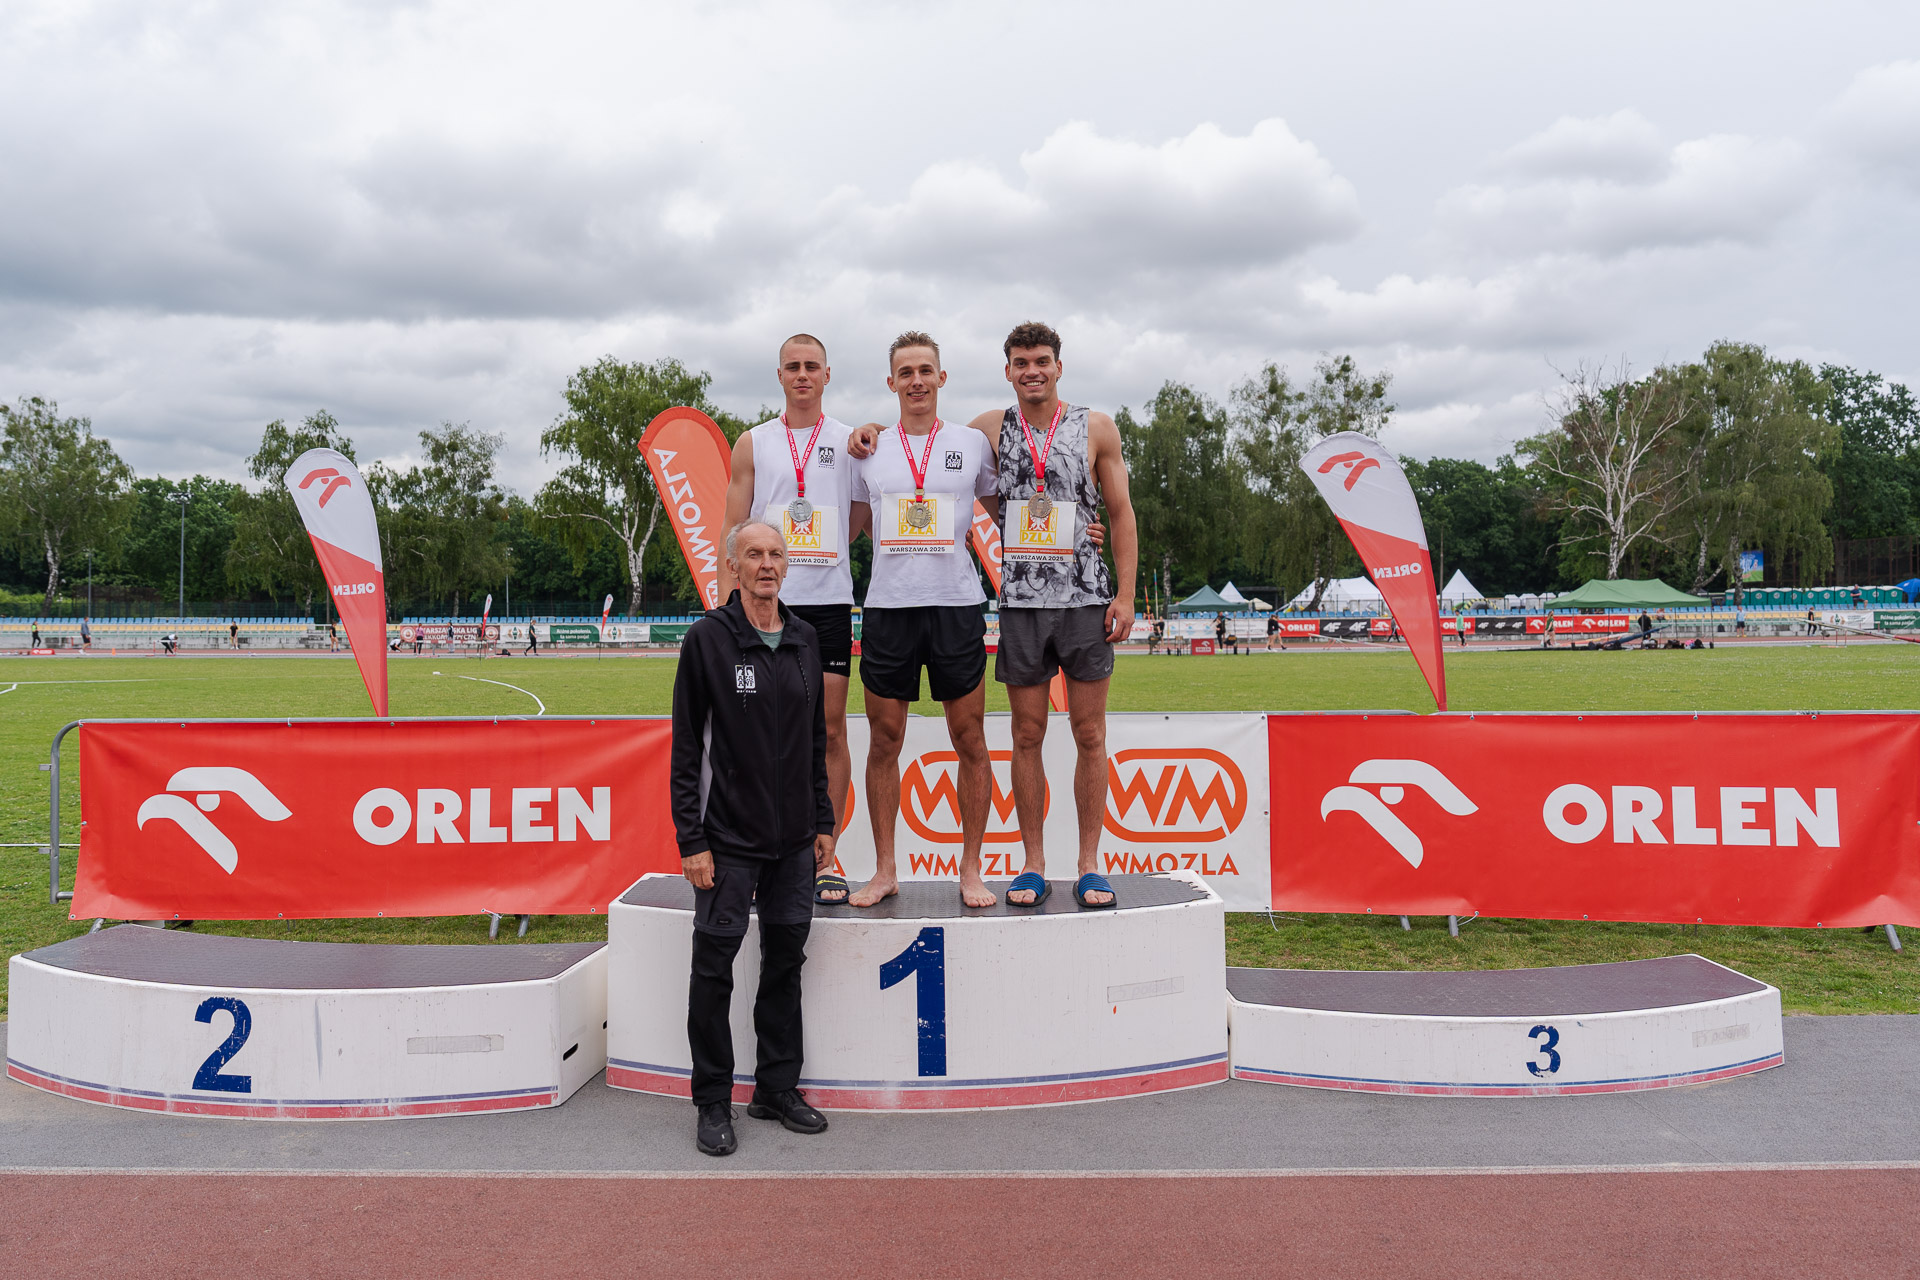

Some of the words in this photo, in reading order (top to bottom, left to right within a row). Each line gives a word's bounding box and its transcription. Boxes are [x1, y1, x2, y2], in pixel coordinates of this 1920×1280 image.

[901, 525, 934, 535] PZLA
[785, 535, 818, 546] PZLA
[1022, 532, 1054, 543] PZLA
[1287, 623, 1316, 632] ORLEN
[1323, 622, 1341, 633] 4F
[1349, 621, 1368, 633] 4F
[1442, 621, 1472, 630] ORN
[1512, 621, 1523, 629] 4F
[1552, 620, 1574, 628] RLEN
[1597, 619, 1626, 628] ORLEN
[352, 786, 611, 846] ORLEN
[1542, 783, 1841, 848] ORLEN
[909, 853, 1026, 877] WMZL
[1104, 852, 1240, 877] WMOZLA
[879, 926, 947, 1077] 1
[191, 996, 253, 1094] 2
[1526, 1023, 1562, 1078] 3
